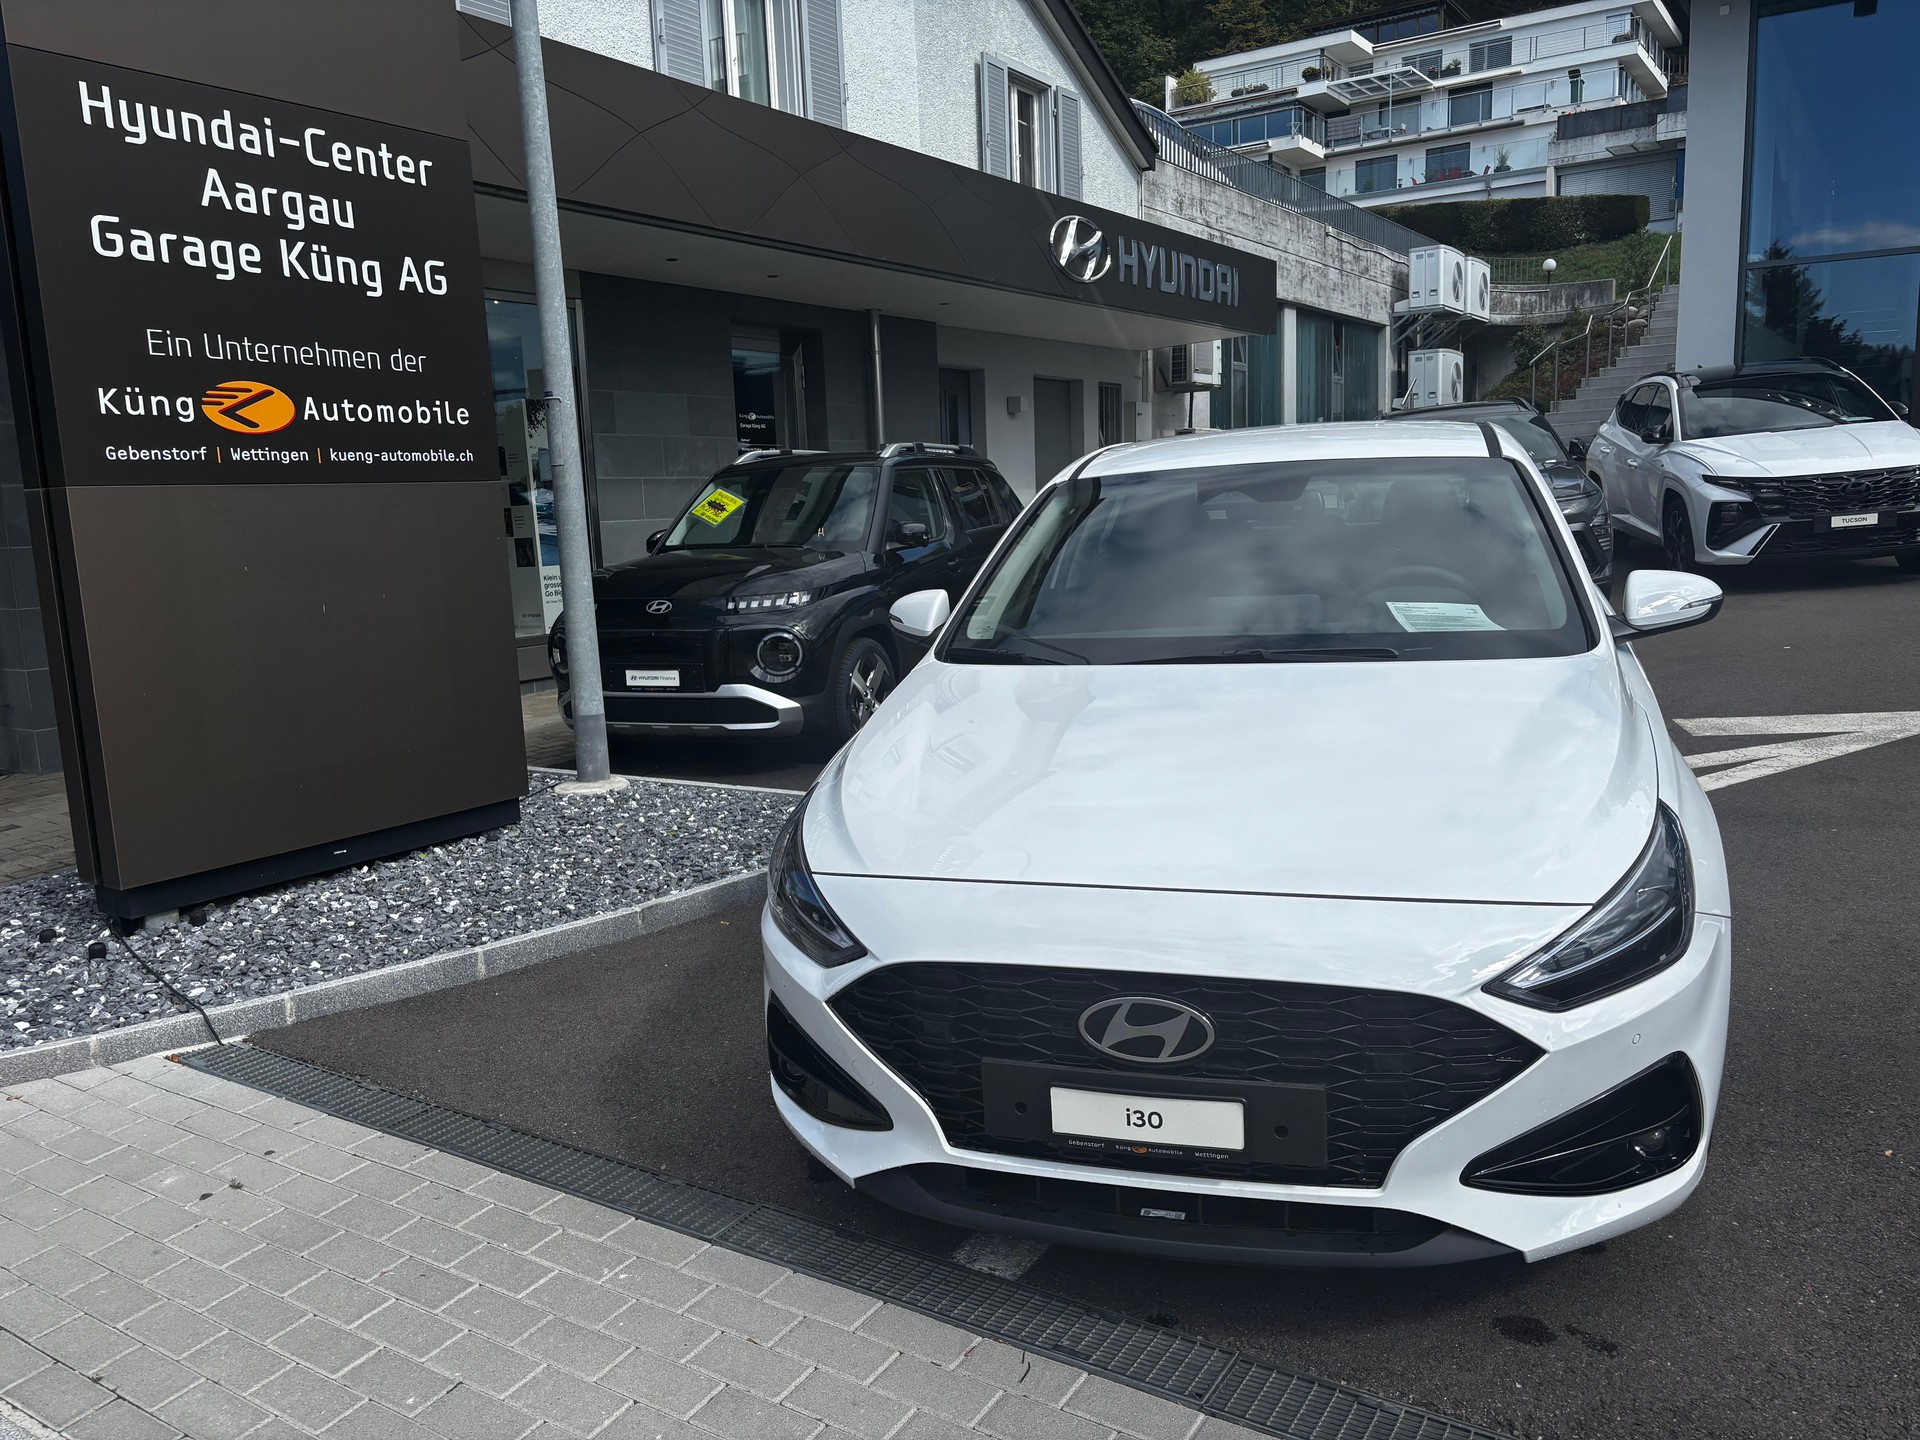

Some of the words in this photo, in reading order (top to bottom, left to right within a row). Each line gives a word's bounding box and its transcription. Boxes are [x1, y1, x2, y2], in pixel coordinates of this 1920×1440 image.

[78, 80, 433, 187] Hyundai-Center
[201, 167, 355, 231] Aargau
[90, 214, 262, 281] Garage
[279, 238, 383, 298] Küng
[398, 256, 448, 296] AG
[1118, 235, 1240, 307] HYUNDAI
[146, 328, 193, 358] Ein
[203, 332, 382, 371] Unternehmen
[390, 348, 427, 373] der
[97, 386, 195, 423] Küng
[303, 396, 470, 425] Automobile
[105, 445, 207, 462] Gebenstorf
[230, 446, 309, 464] Wettingen
[330, 447, 474, 465] kueng-automobile.ch
[1841, 516, 1868, 524] TUCSON
[1125, 1107, 1164, 1130] i30
[1068, 1139, 1105, 1148] Gebenstorf
[1115, 1144, 1132, 1152] Küng
[1148, 1147, 1183, 1156] Automobile
[1194, 1151, 1229, 1160] Wettingen
